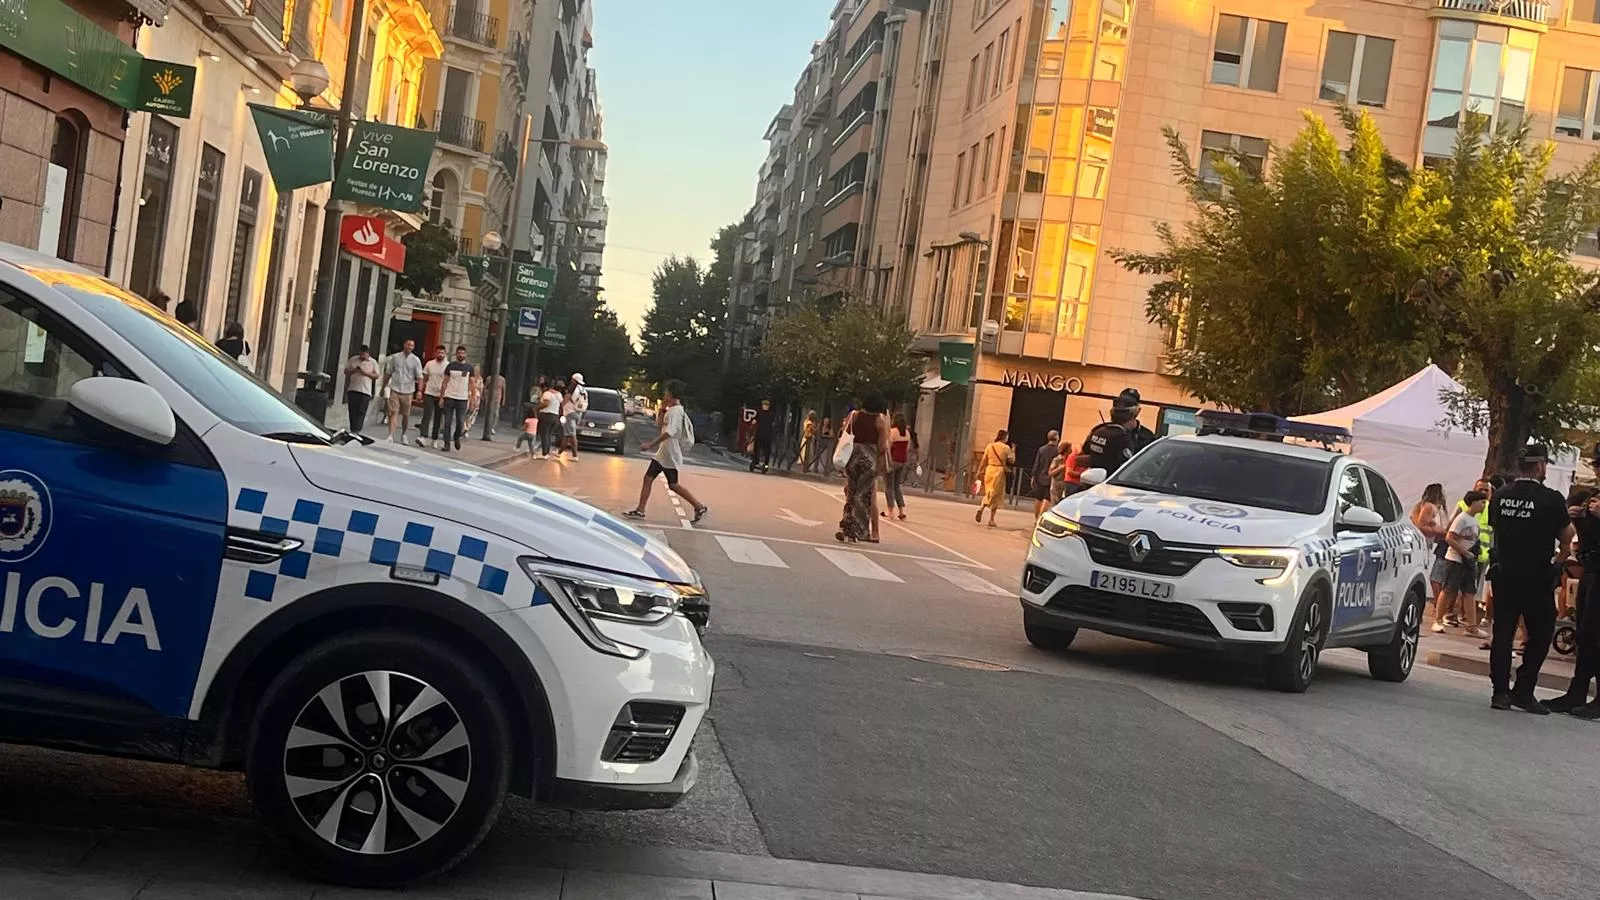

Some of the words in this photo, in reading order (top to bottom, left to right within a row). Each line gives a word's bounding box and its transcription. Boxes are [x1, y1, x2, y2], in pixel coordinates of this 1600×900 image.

[299, 128, 325, 138] Huesca
[362, 130, 394, 144] vive
[357, 141, 389, 158] San
[353, 155, 419, 179] Lorenzo
[351, 186, 376, 198] Huesca
[518, 265, 534, 277] San
[516, 273, 549, 288] Lorenzo
[1001, 368, 1083, 394] MANGO
[1100, 575, 1137, 593] 2195
[1141, 581, 1171, 598] LZJ
[0, 571, 162, 651] ICIA
